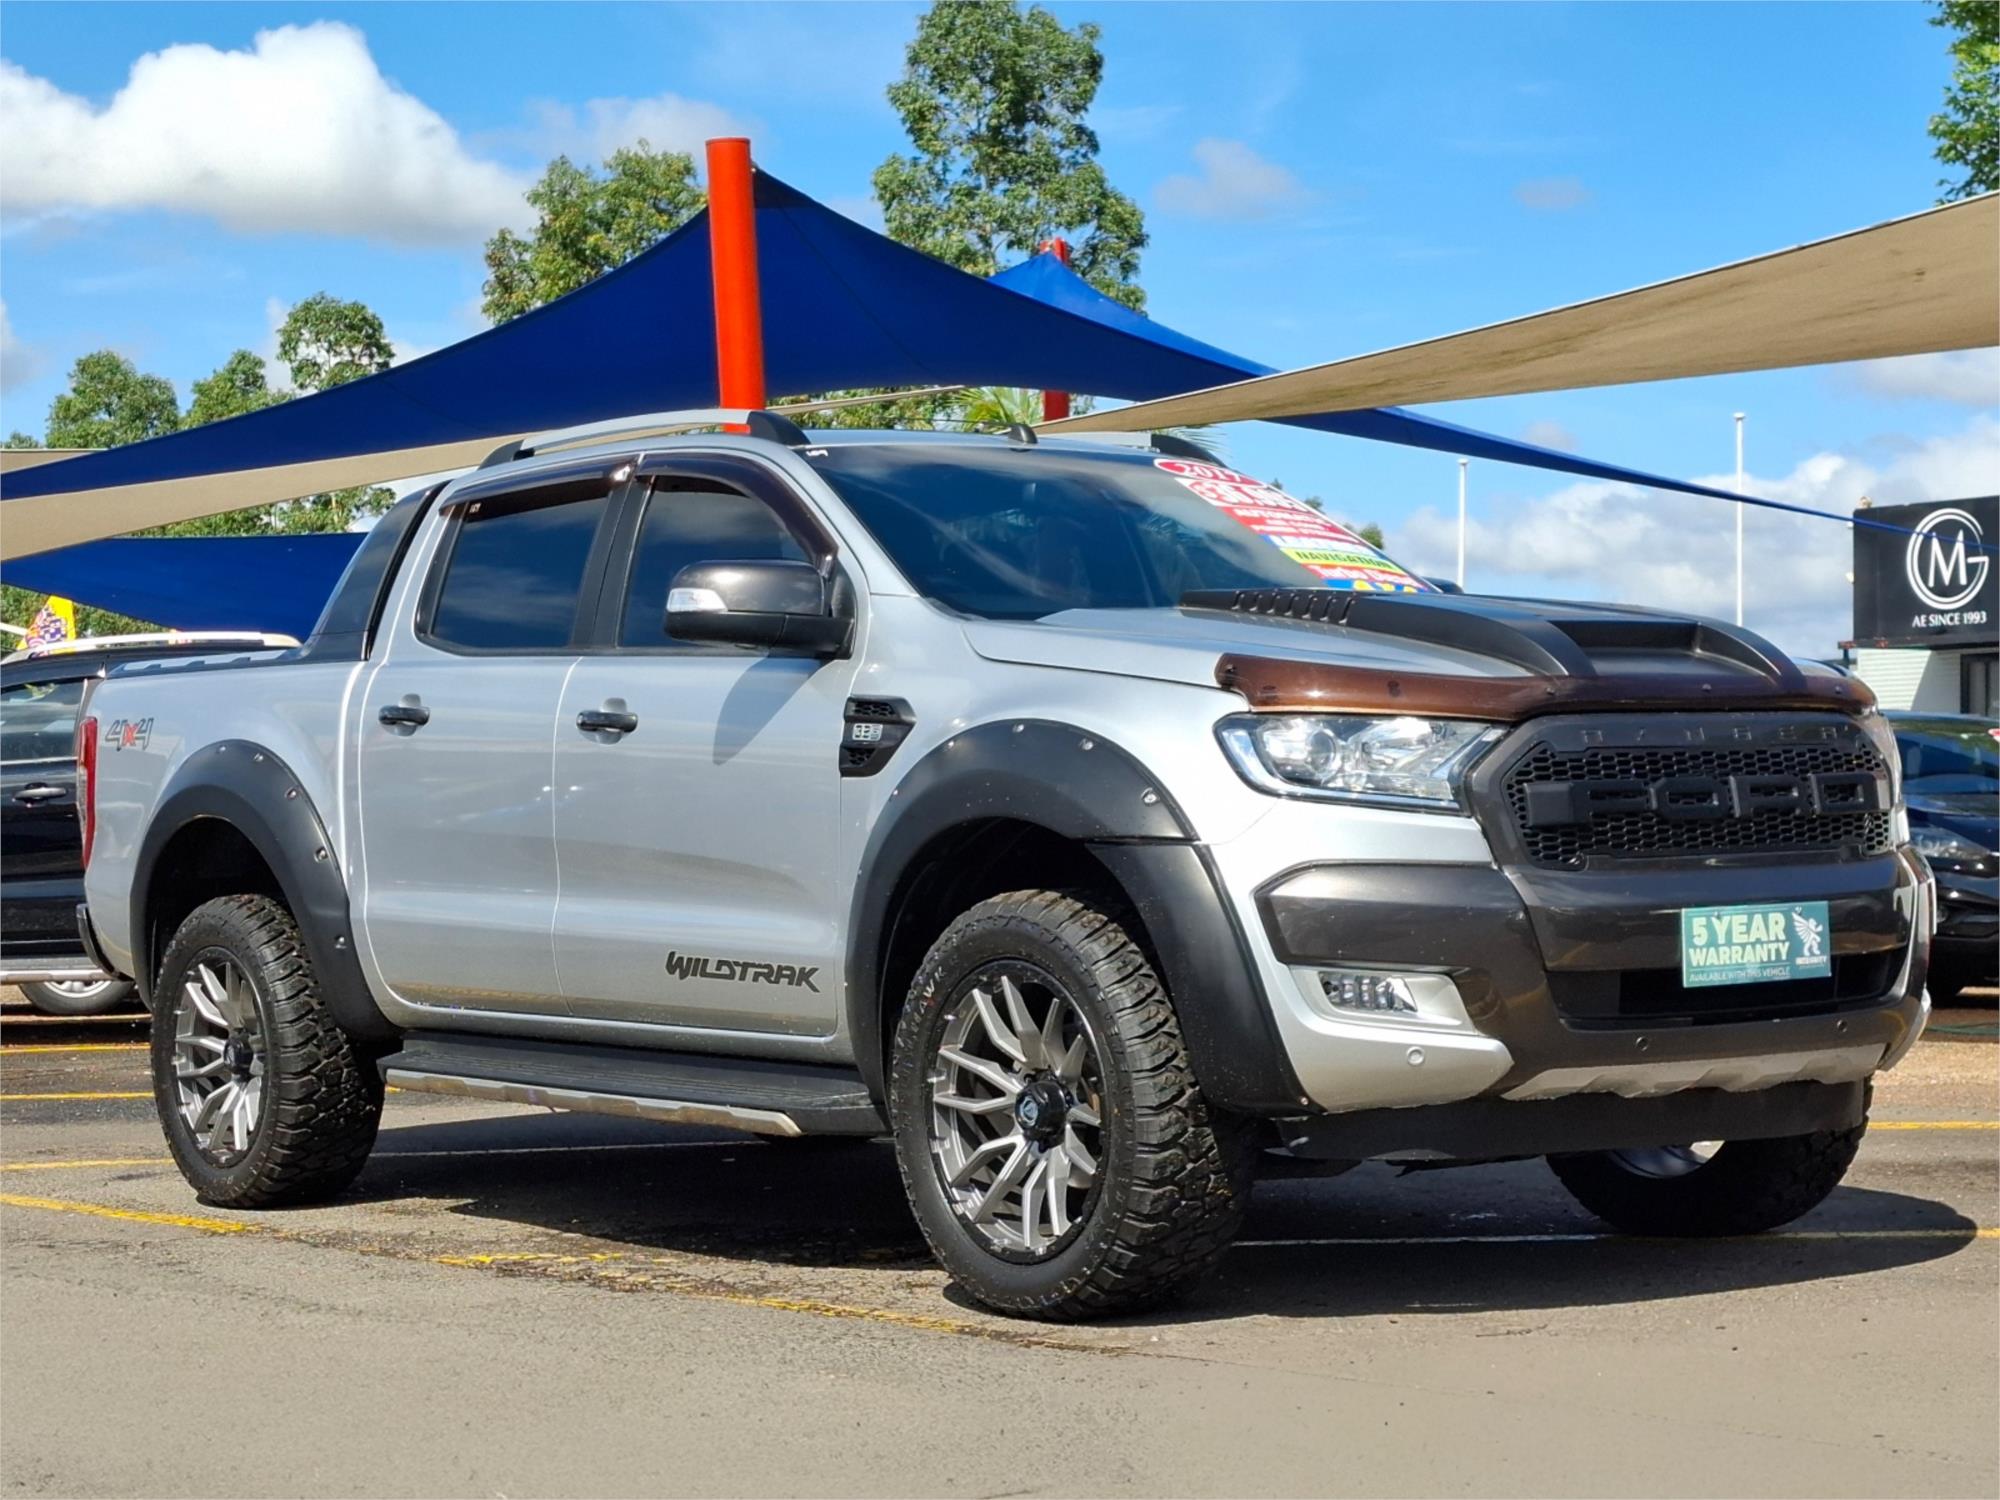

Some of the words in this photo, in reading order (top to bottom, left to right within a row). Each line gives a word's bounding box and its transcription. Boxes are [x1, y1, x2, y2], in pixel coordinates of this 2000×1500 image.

[1174, 463, 1241, 482] 2017
[1294, 551, 1393, 570] NAVIGATION
[1911, 614, 1927, 628] AE
[1928, 612, 1961, 627] SINCE
[1962, 610, 1987, 625] 1993
[1692, 916, 1708, 946] 5
[1710, 912, 1787, 945] YEAR
[1689, 941, 1791, 967] WARRANTY
[665, 951, 820, 993] WILDTRAK
[1763, 966, 1791, 977] VEHICLE
